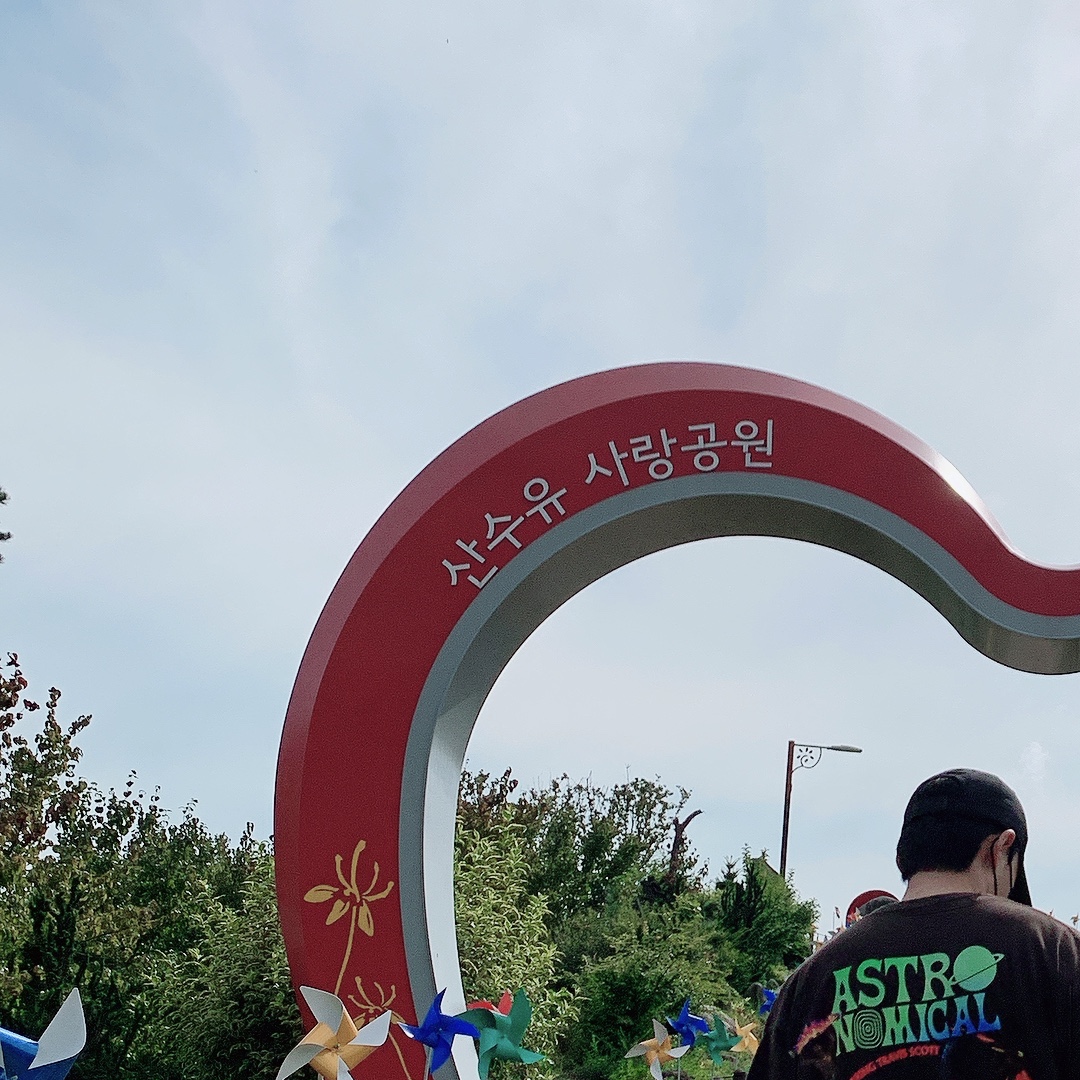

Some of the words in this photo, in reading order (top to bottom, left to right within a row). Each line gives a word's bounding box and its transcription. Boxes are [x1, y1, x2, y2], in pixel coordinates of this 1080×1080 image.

[441, 477, 568, 589] 산수유
[584, 418, 774, 487] 사랑공원
[833, 992, 1001, 1058] NOMICAL
[908, 1044, 942, 1058] SCOTT
